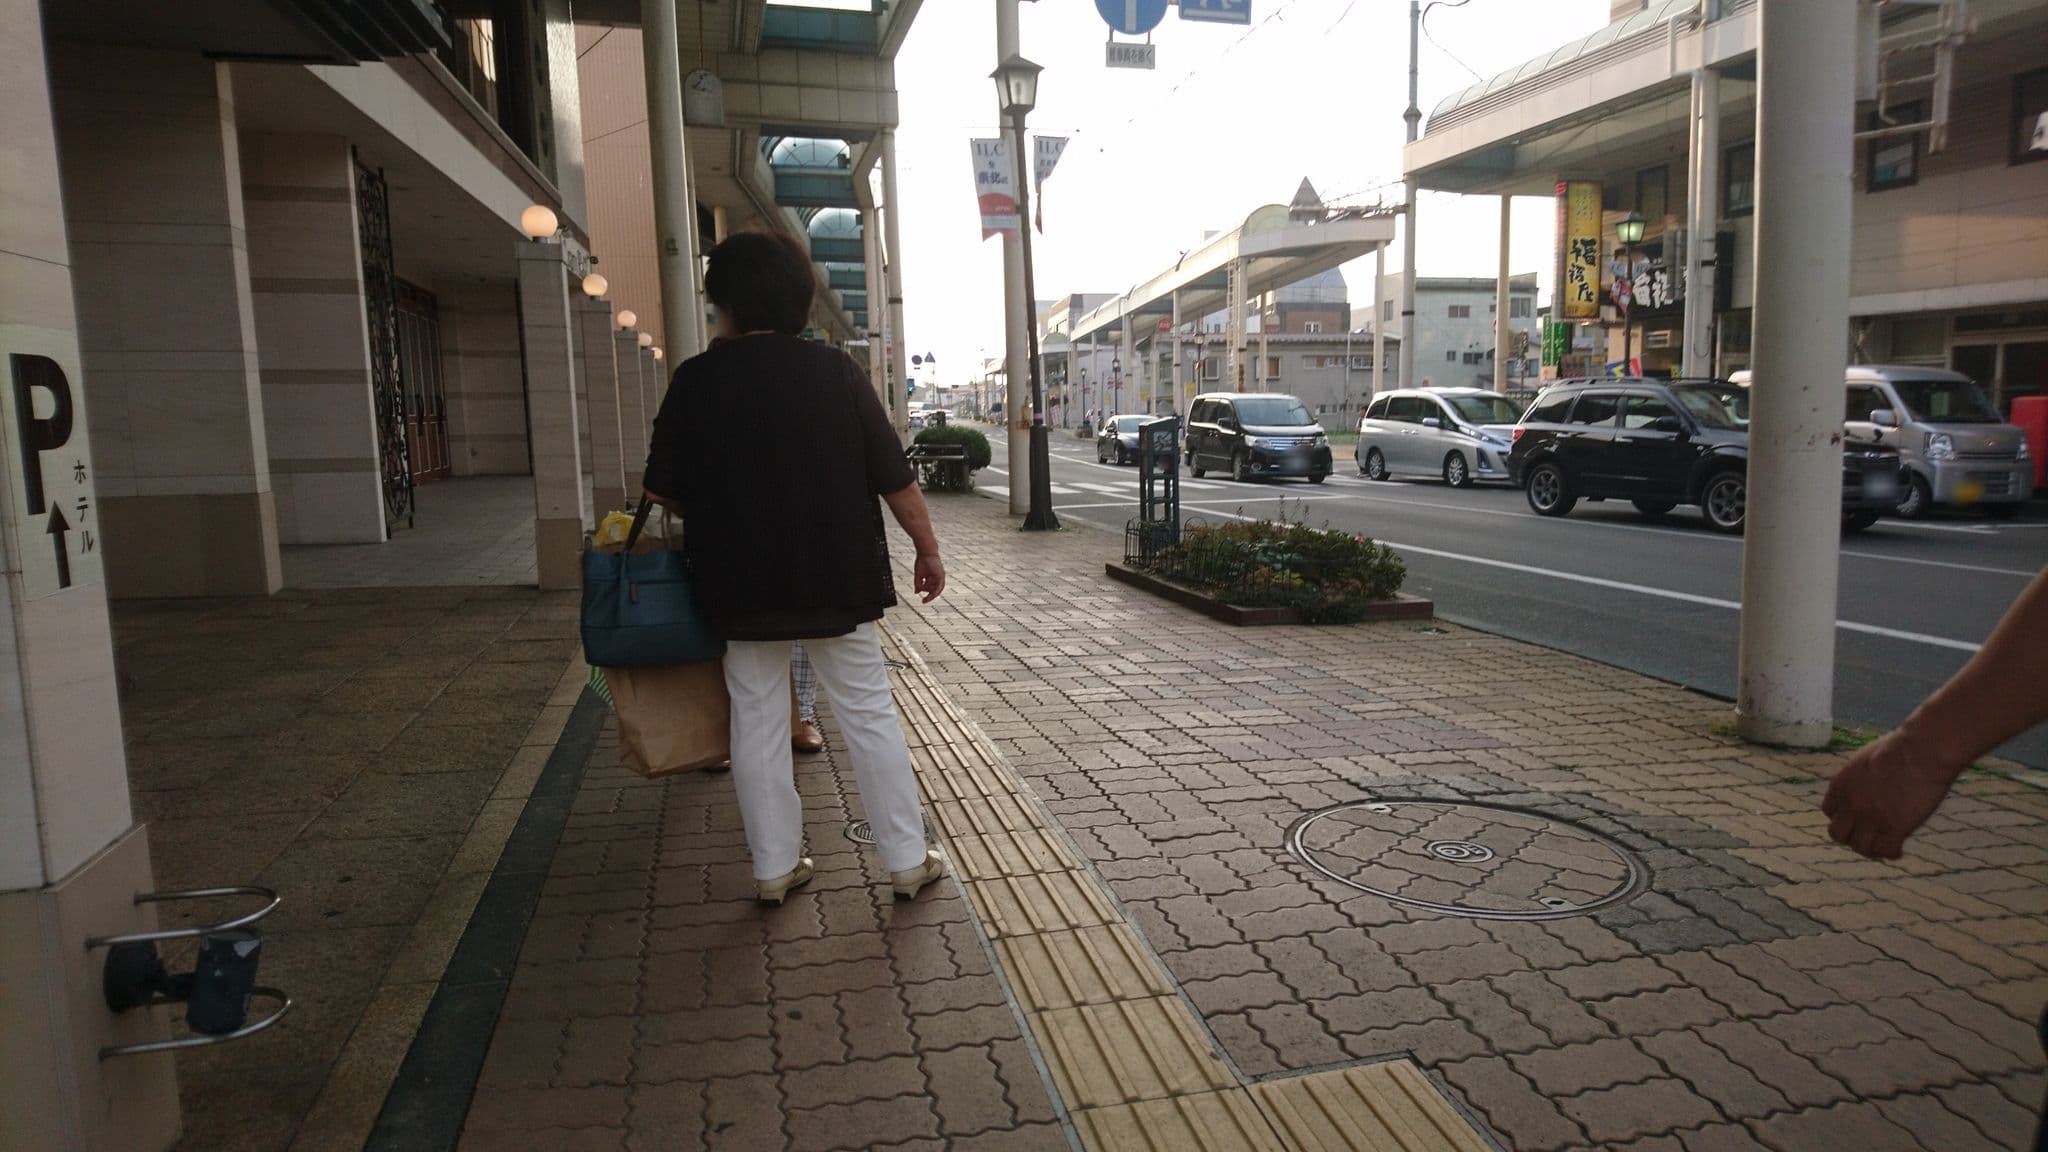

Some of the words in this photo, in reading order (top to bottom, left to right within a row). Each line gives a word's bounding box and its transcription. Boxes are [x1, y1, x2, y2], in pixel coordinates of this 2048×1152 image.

[977, 143, 1004, 156] ILC
[9, 352, 73, 516] P
[73, 459, 95, 555] ホテル
